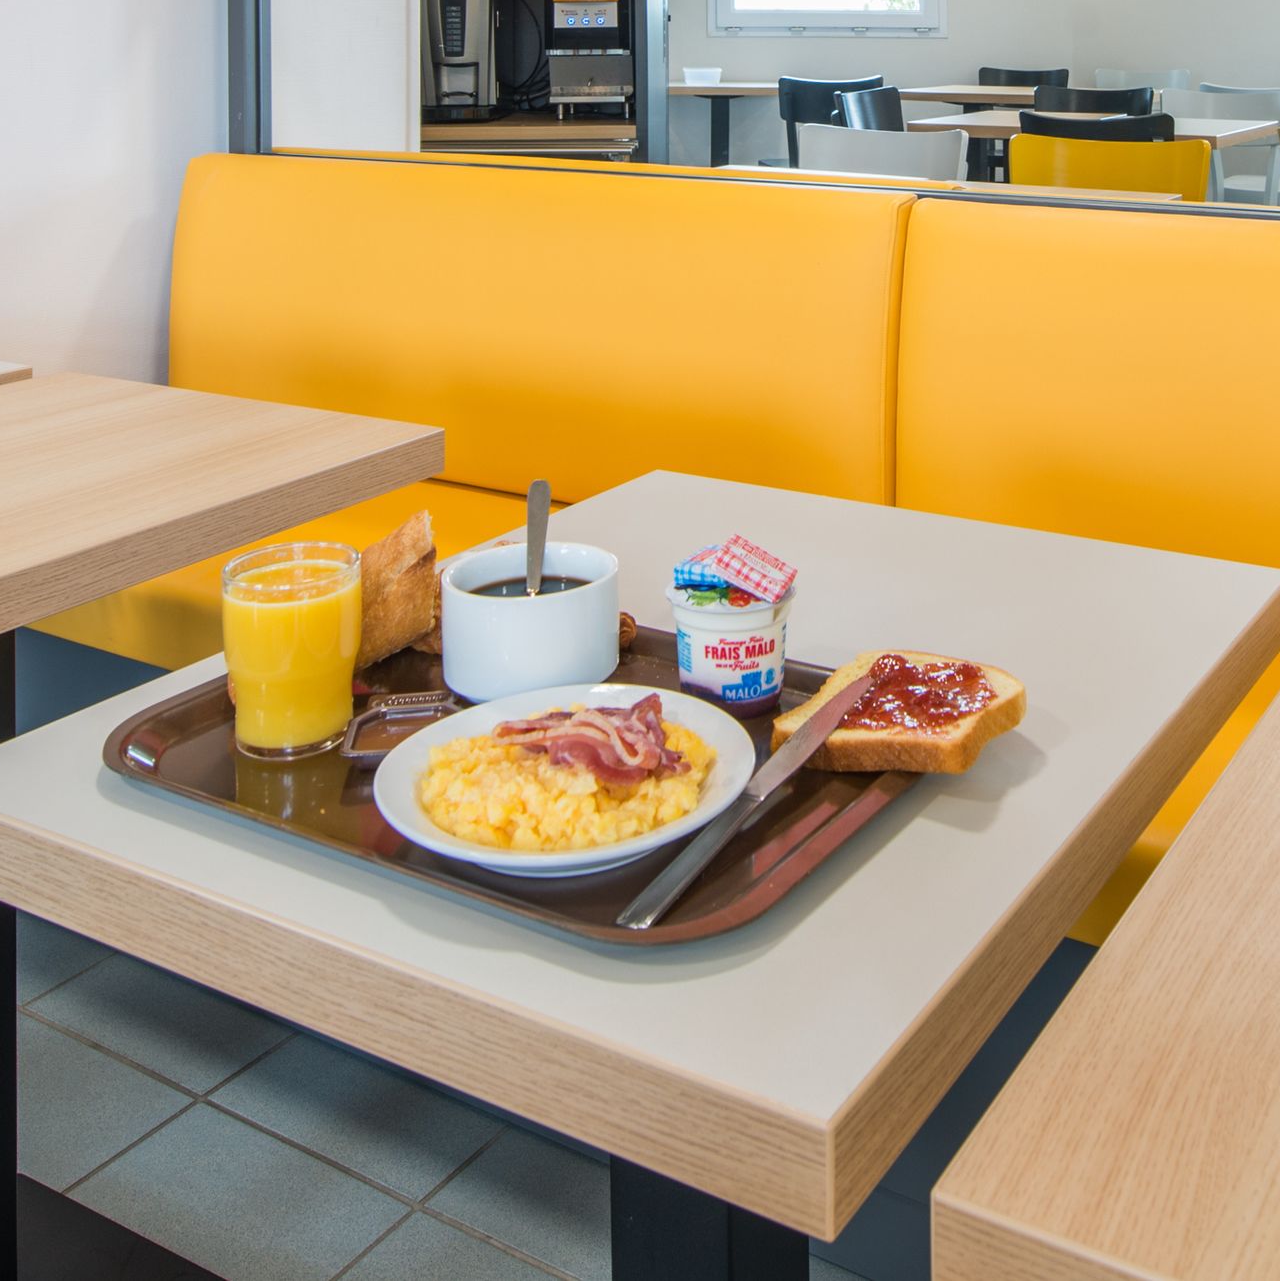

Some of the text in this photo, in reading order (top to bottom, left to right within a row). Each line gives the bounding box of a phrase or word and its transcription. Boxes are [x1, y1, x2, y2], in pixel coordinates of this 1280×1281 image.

[704, 639, 775, 661] FRAIS MALO
[731, 660, 760, 672] Fruits
[725, 684, 761, 700] MALO
